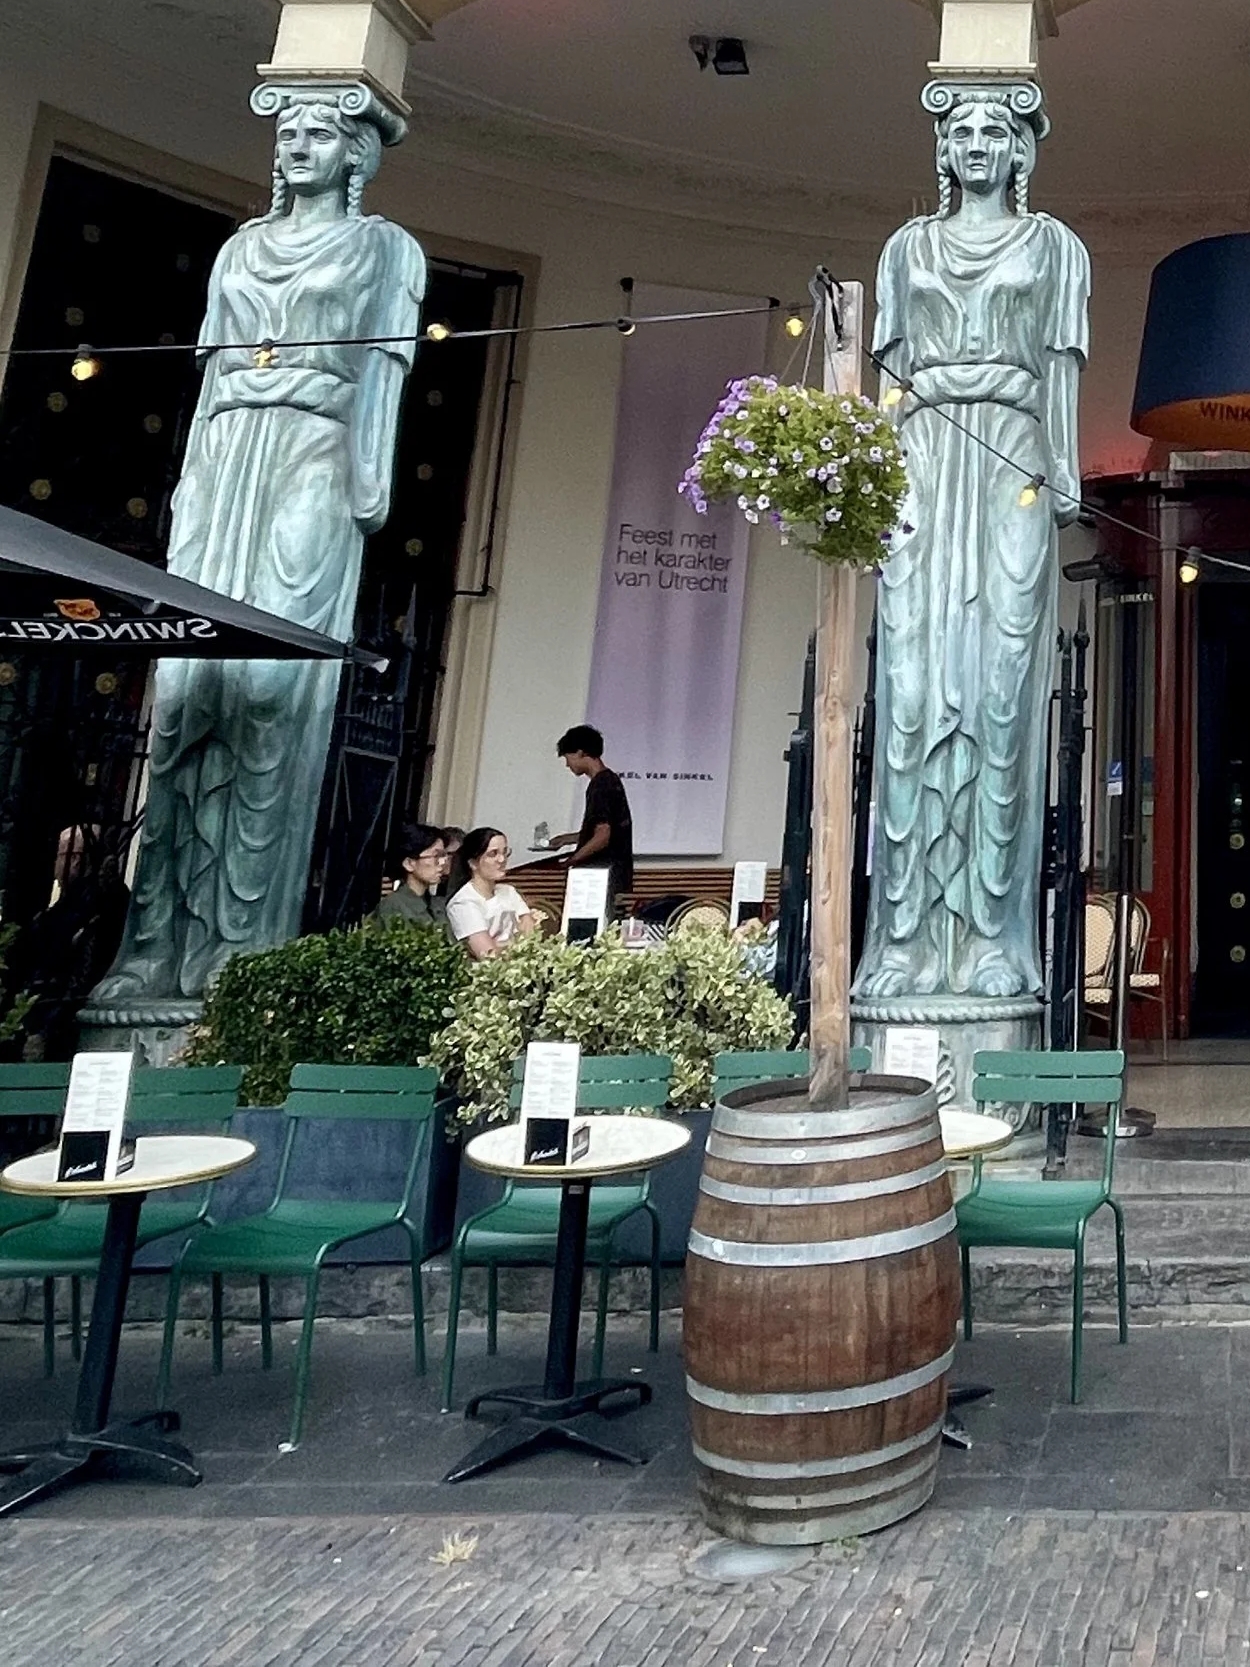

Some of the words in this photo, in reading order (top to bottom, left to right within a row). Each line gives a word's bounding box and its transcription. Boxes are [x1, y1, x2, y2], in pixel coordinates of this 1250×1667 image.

[620, 523, 674, 547] Feest
[680, 532, 717, 550] met
[616, 545, 648, 566] het
[655, 547, 733, 572] karakter
[615, 571, 651, 588] van
[659, 570, 728, 593] Utrecht
